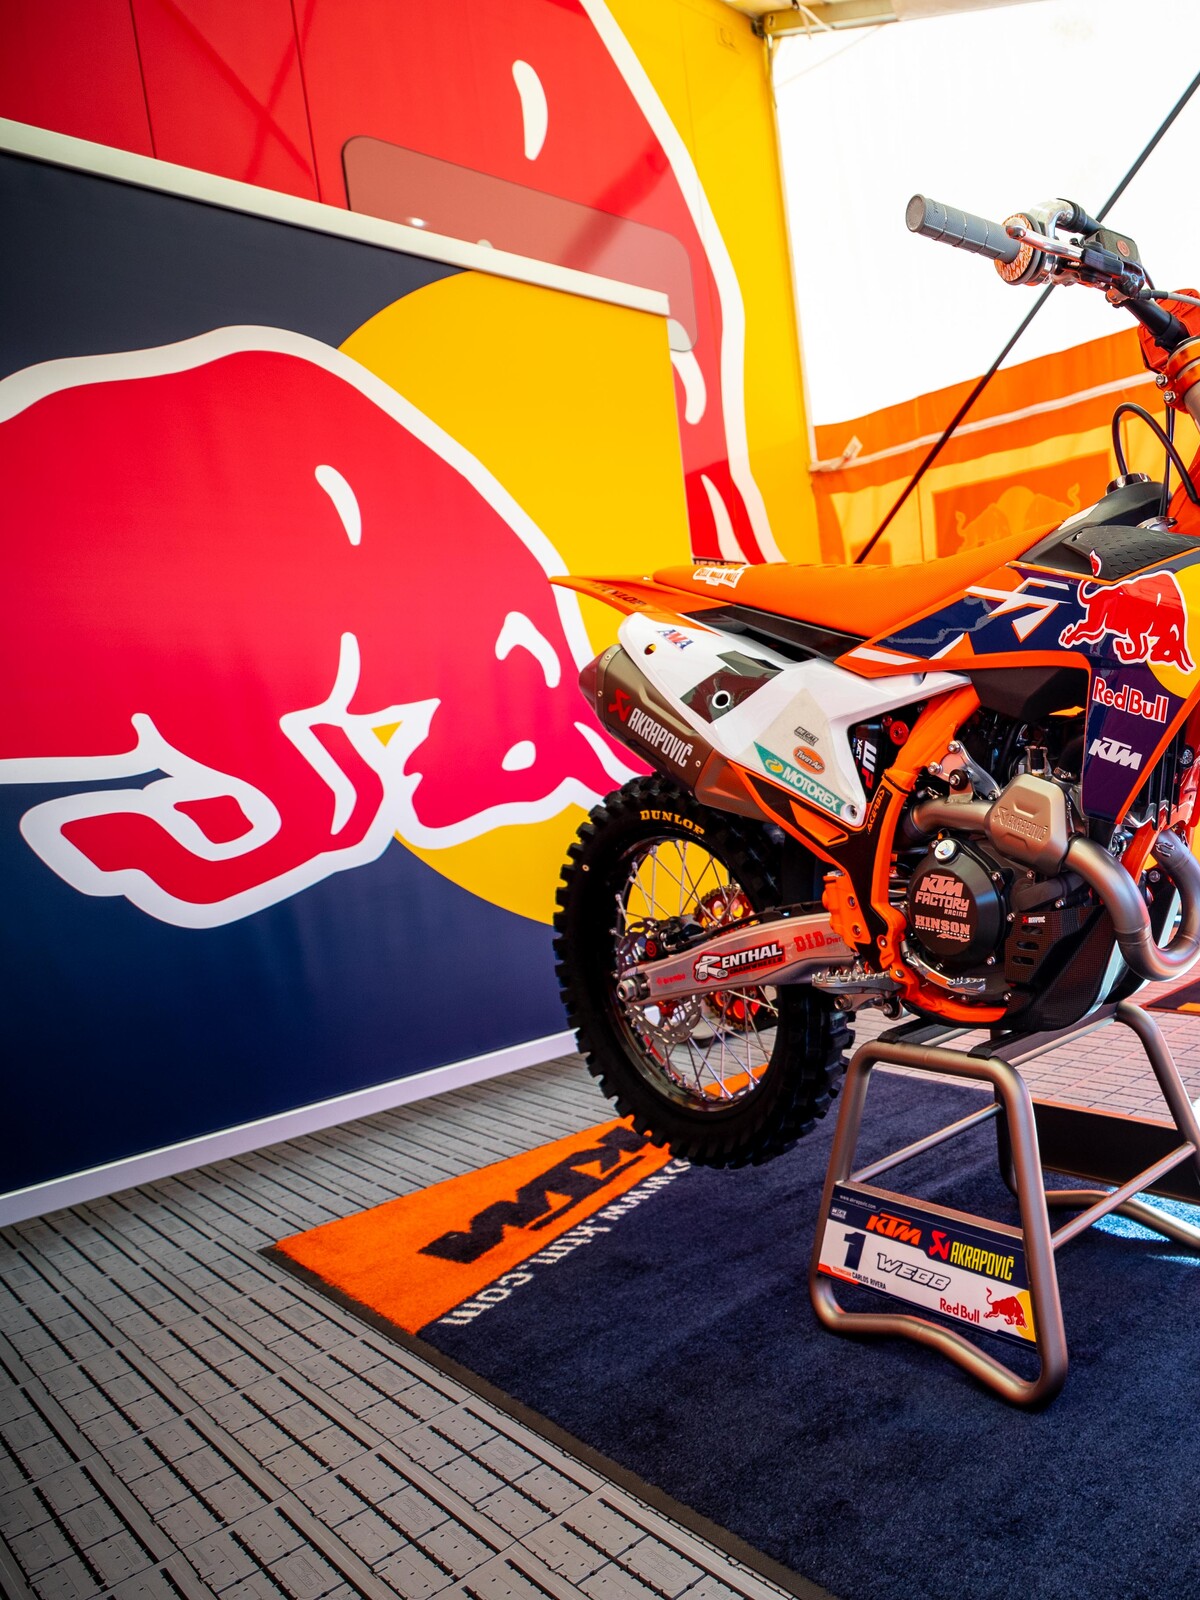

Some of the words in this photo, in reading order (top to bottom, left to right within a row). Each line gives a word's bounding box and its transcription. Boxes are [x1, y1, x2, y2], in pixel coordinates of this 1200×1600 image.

[1092, 676, 1129, 711] Red
[1127, 688, 1169, 723] Bull
[627, 707, 694, 768] AKRAPOVIČ
[1088, 736, 1143, 771] KTM
[796, 749, 813, 765] Twin
[811, 759, 825, 771] Air
[862, 741, 877, 790] WP
[782, 766, 839, 812] MOTOREX
[640, 809, 706, 836] DUNLOP
[867, 788, 886, 833] ACERBIS
[914, 890, 970, 912] FACTORY
[920, 873, 964, 898] KTM
[914, 914, 971, 935] HINSON
[843, 1231, 867, 1271] 1
[865, 1212, 922, 1246] KTM
[949, 1241, 1015, 1281] AKRAPOVIČ
[851, 1271, 870, 1284] CARLOS
[869, 1277, 887, 1290] RIVERA
[877, 1252, 951, 1292] WEBB
[939, 1297, 959, 1316] Red
[960, 1304, 980, 1323] Bull
